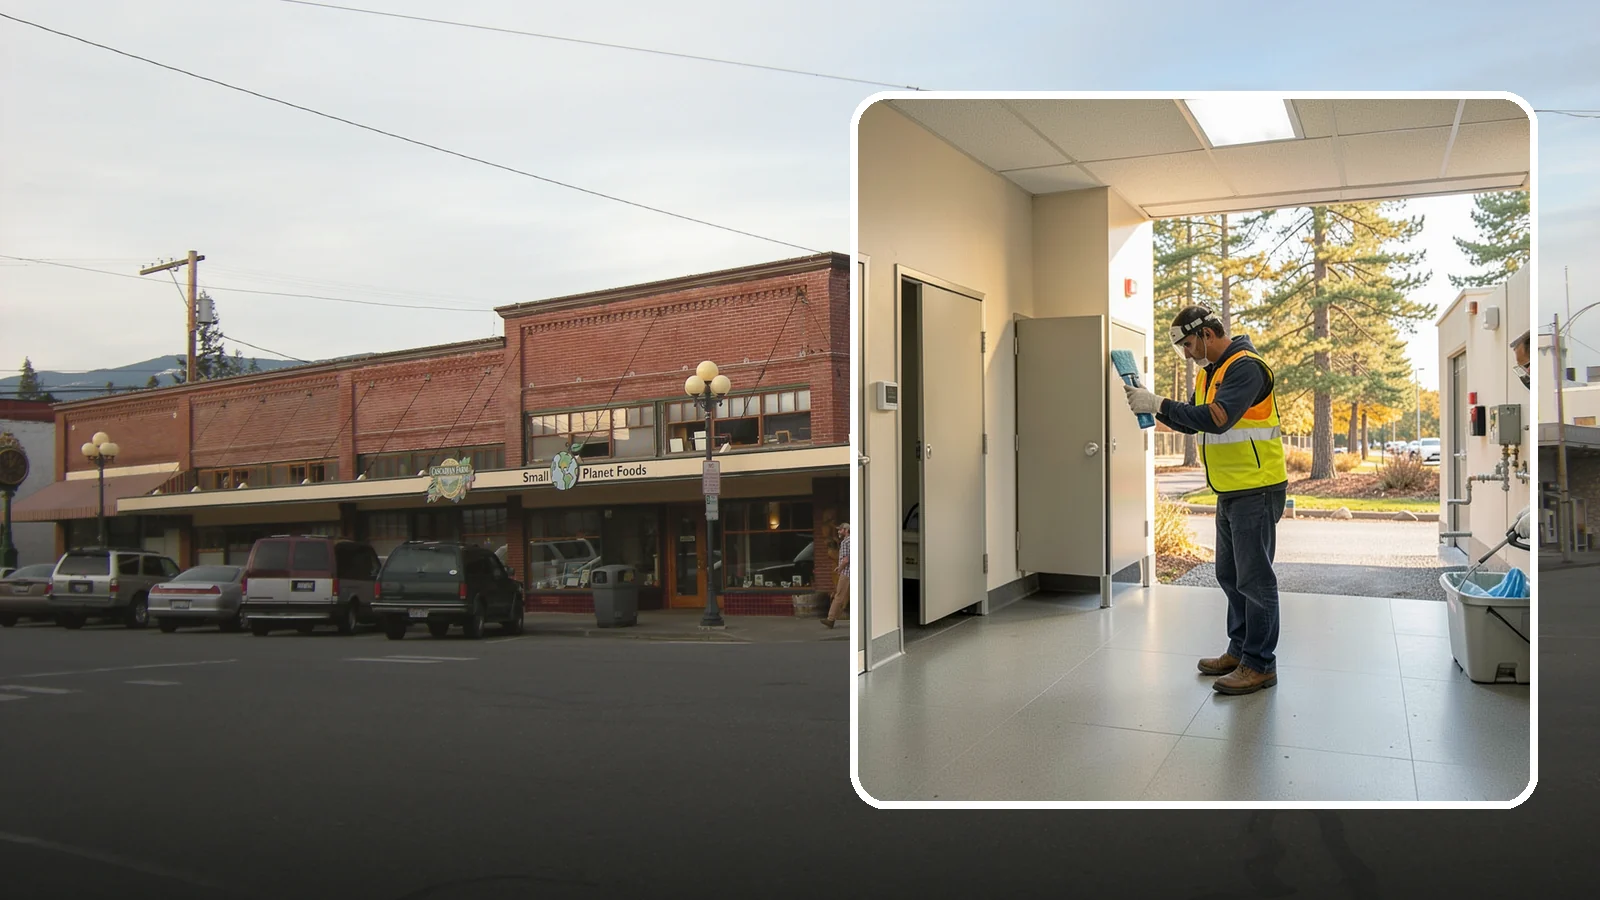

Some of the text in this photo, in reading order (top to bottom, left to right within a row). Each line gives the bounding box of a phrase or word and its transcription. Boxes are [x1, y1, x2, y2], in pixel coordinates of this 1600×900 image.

[522, 464, 647, 483] Small Planet Foods
